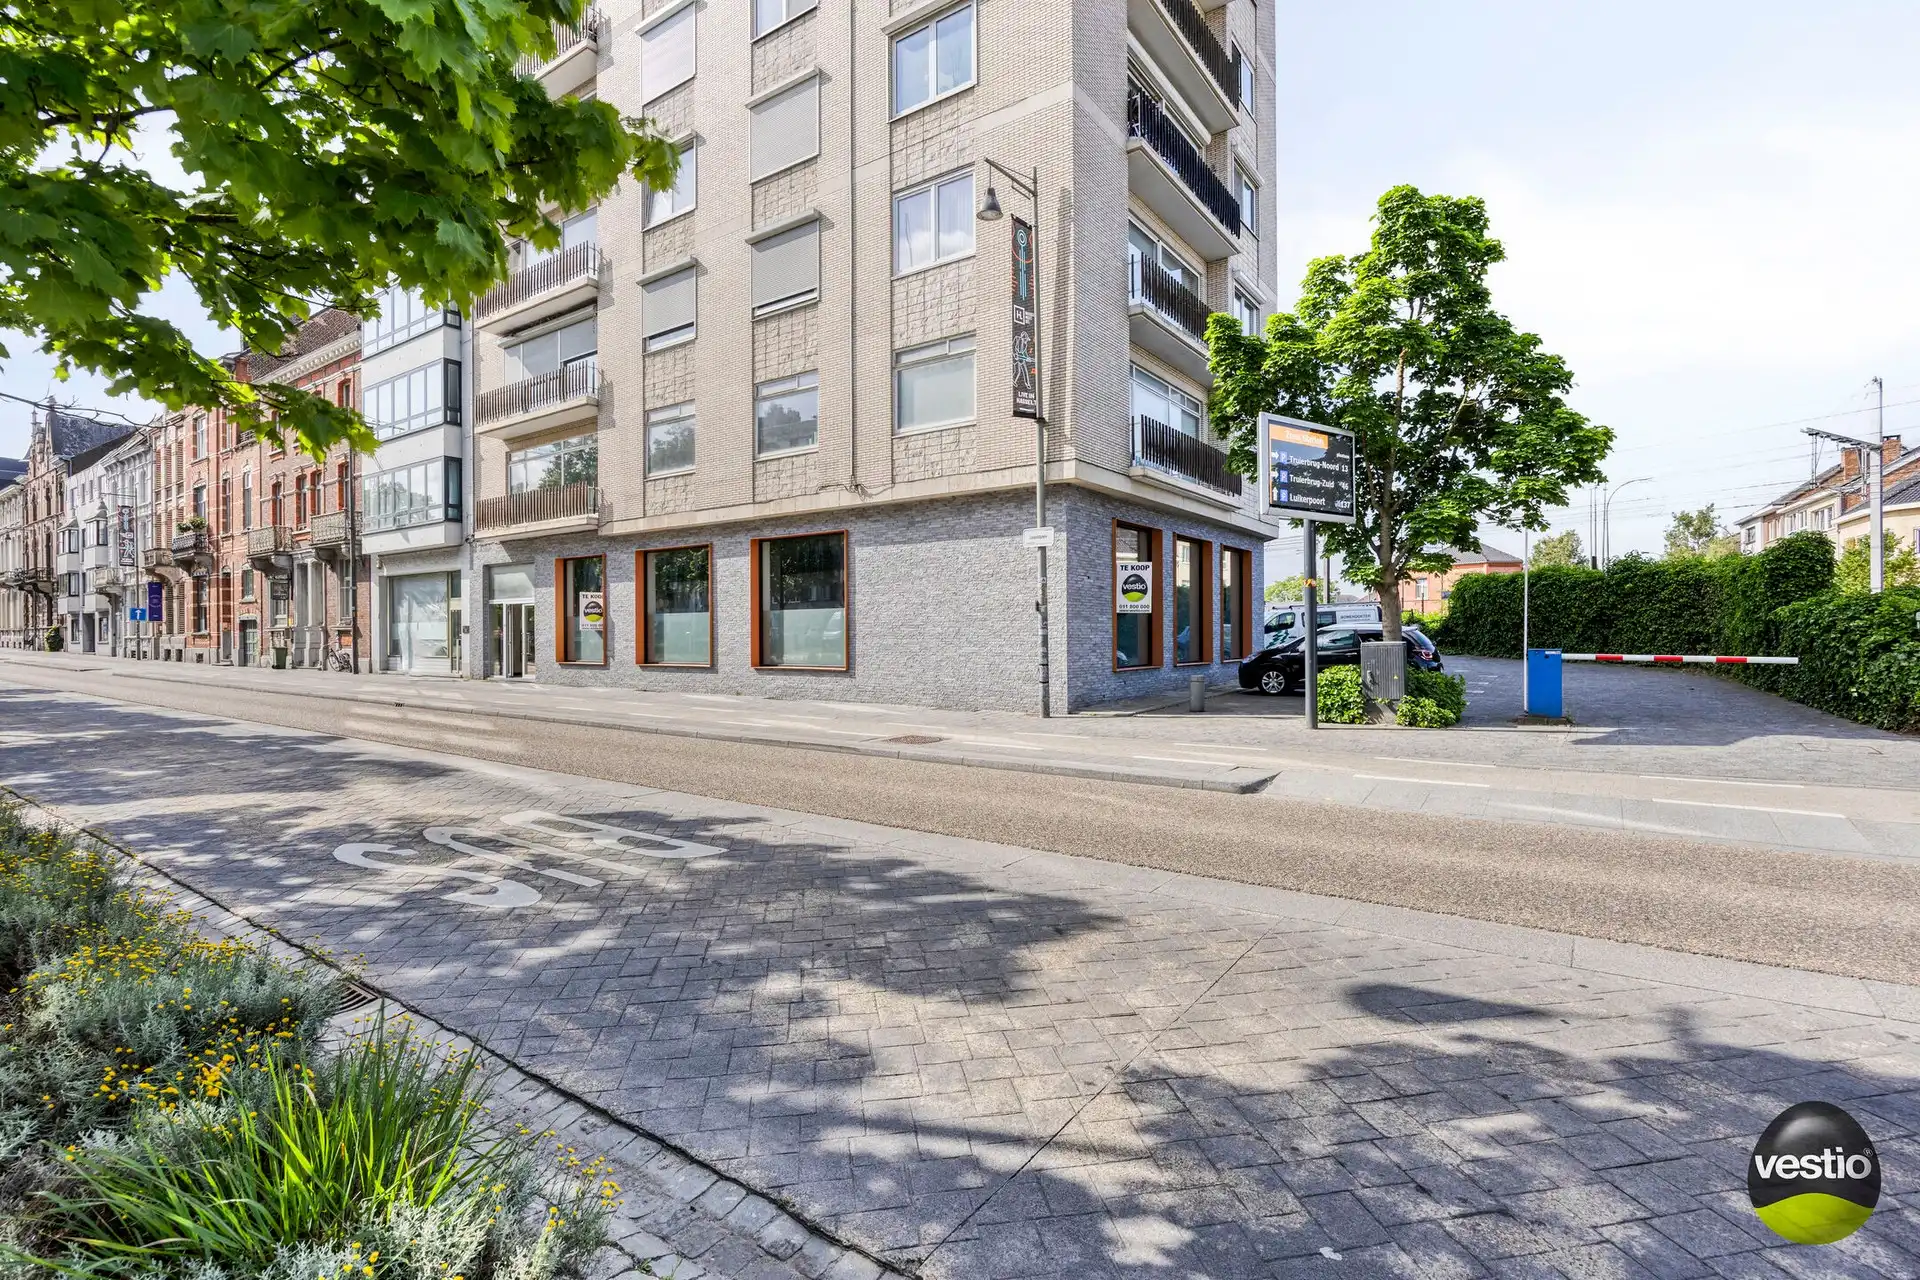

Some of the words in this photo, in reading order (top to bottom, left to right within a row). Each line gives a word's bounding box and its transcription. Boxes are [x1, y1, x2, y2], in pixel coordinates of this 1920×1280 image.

[1290, 455, 1340, 471] Truierbrug-Noord
[1290, 474, 1335, 488] Truierbrug-Zuid
[1290, 493, 1325, 506] Luikerpoort
[1122, 582, 1146, 590] vestio
[333, 809, 730, 908] BUS
